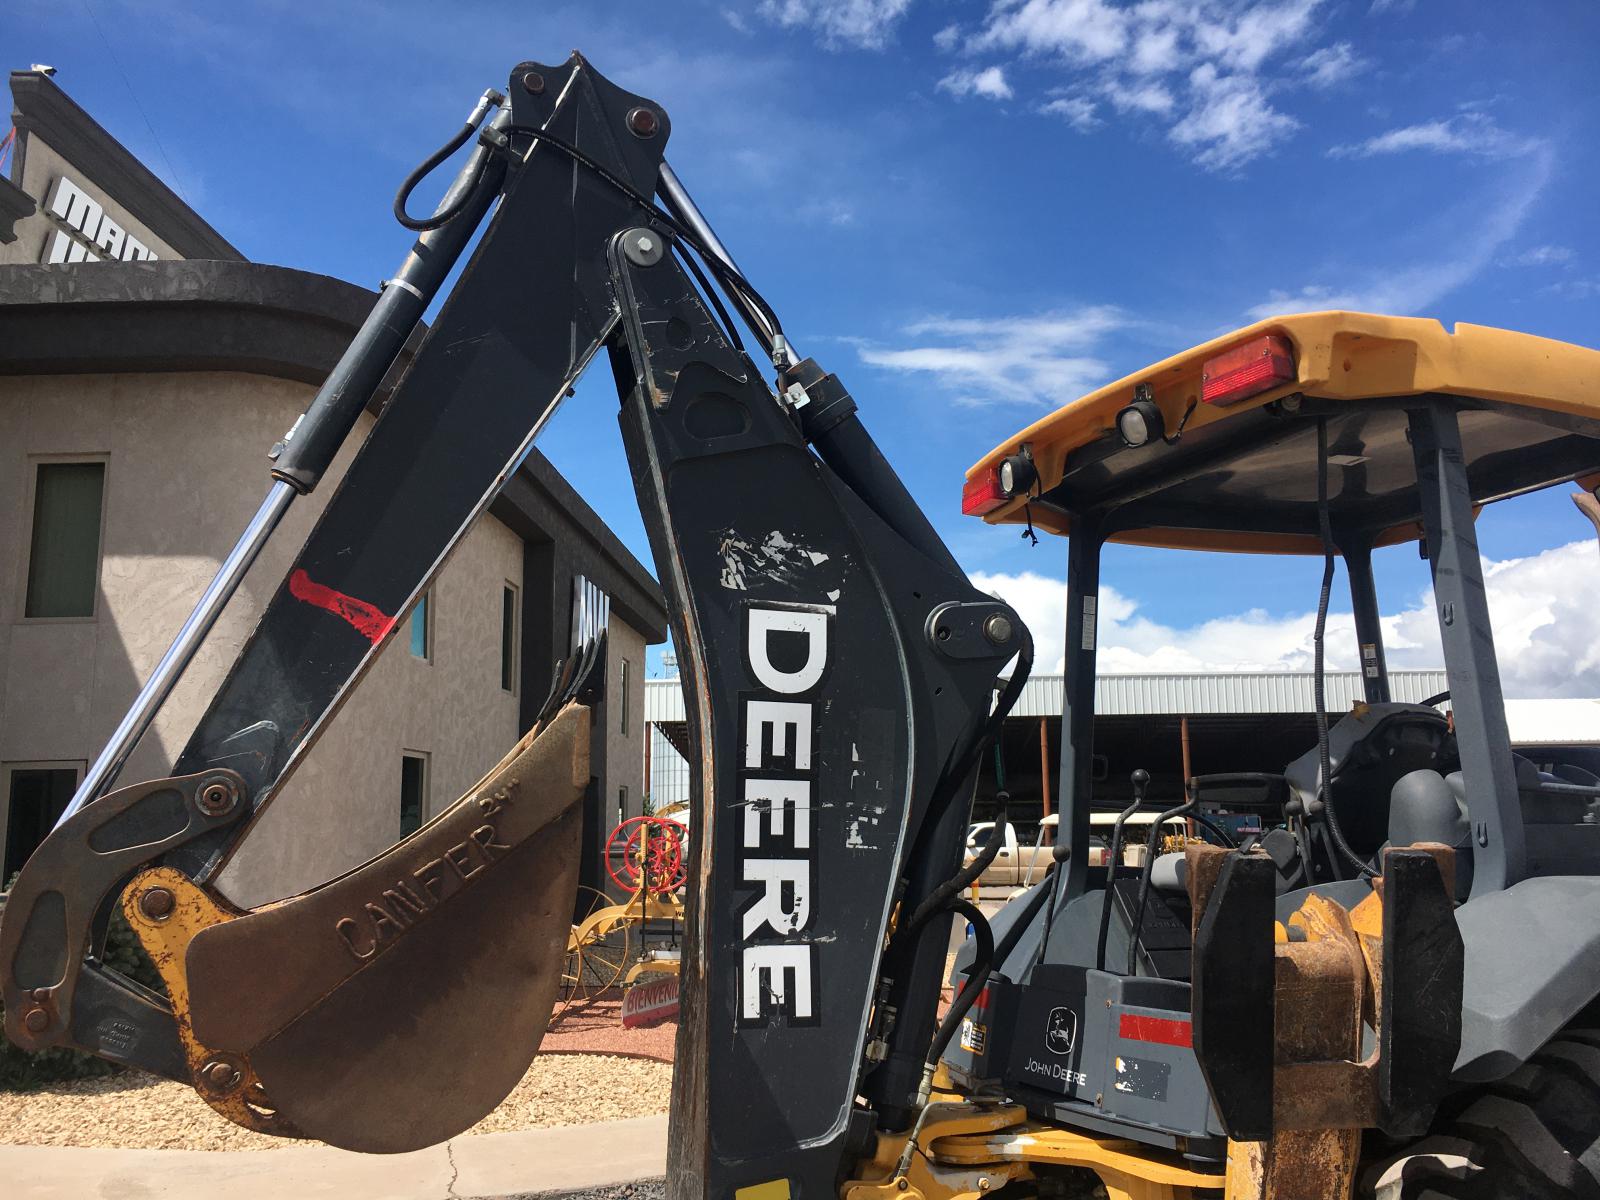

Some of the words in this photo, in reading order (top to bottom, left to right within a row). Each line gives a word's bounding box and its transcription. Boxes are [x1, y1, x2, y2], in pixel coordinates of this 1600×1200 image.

[742, 608, 828, 1019] DEERE
[335, 824, 511, 959] CANFER
[1024, 1057, 1052, 1076] JOHN
[1052, 1064, 1087, 1086] DEERE
